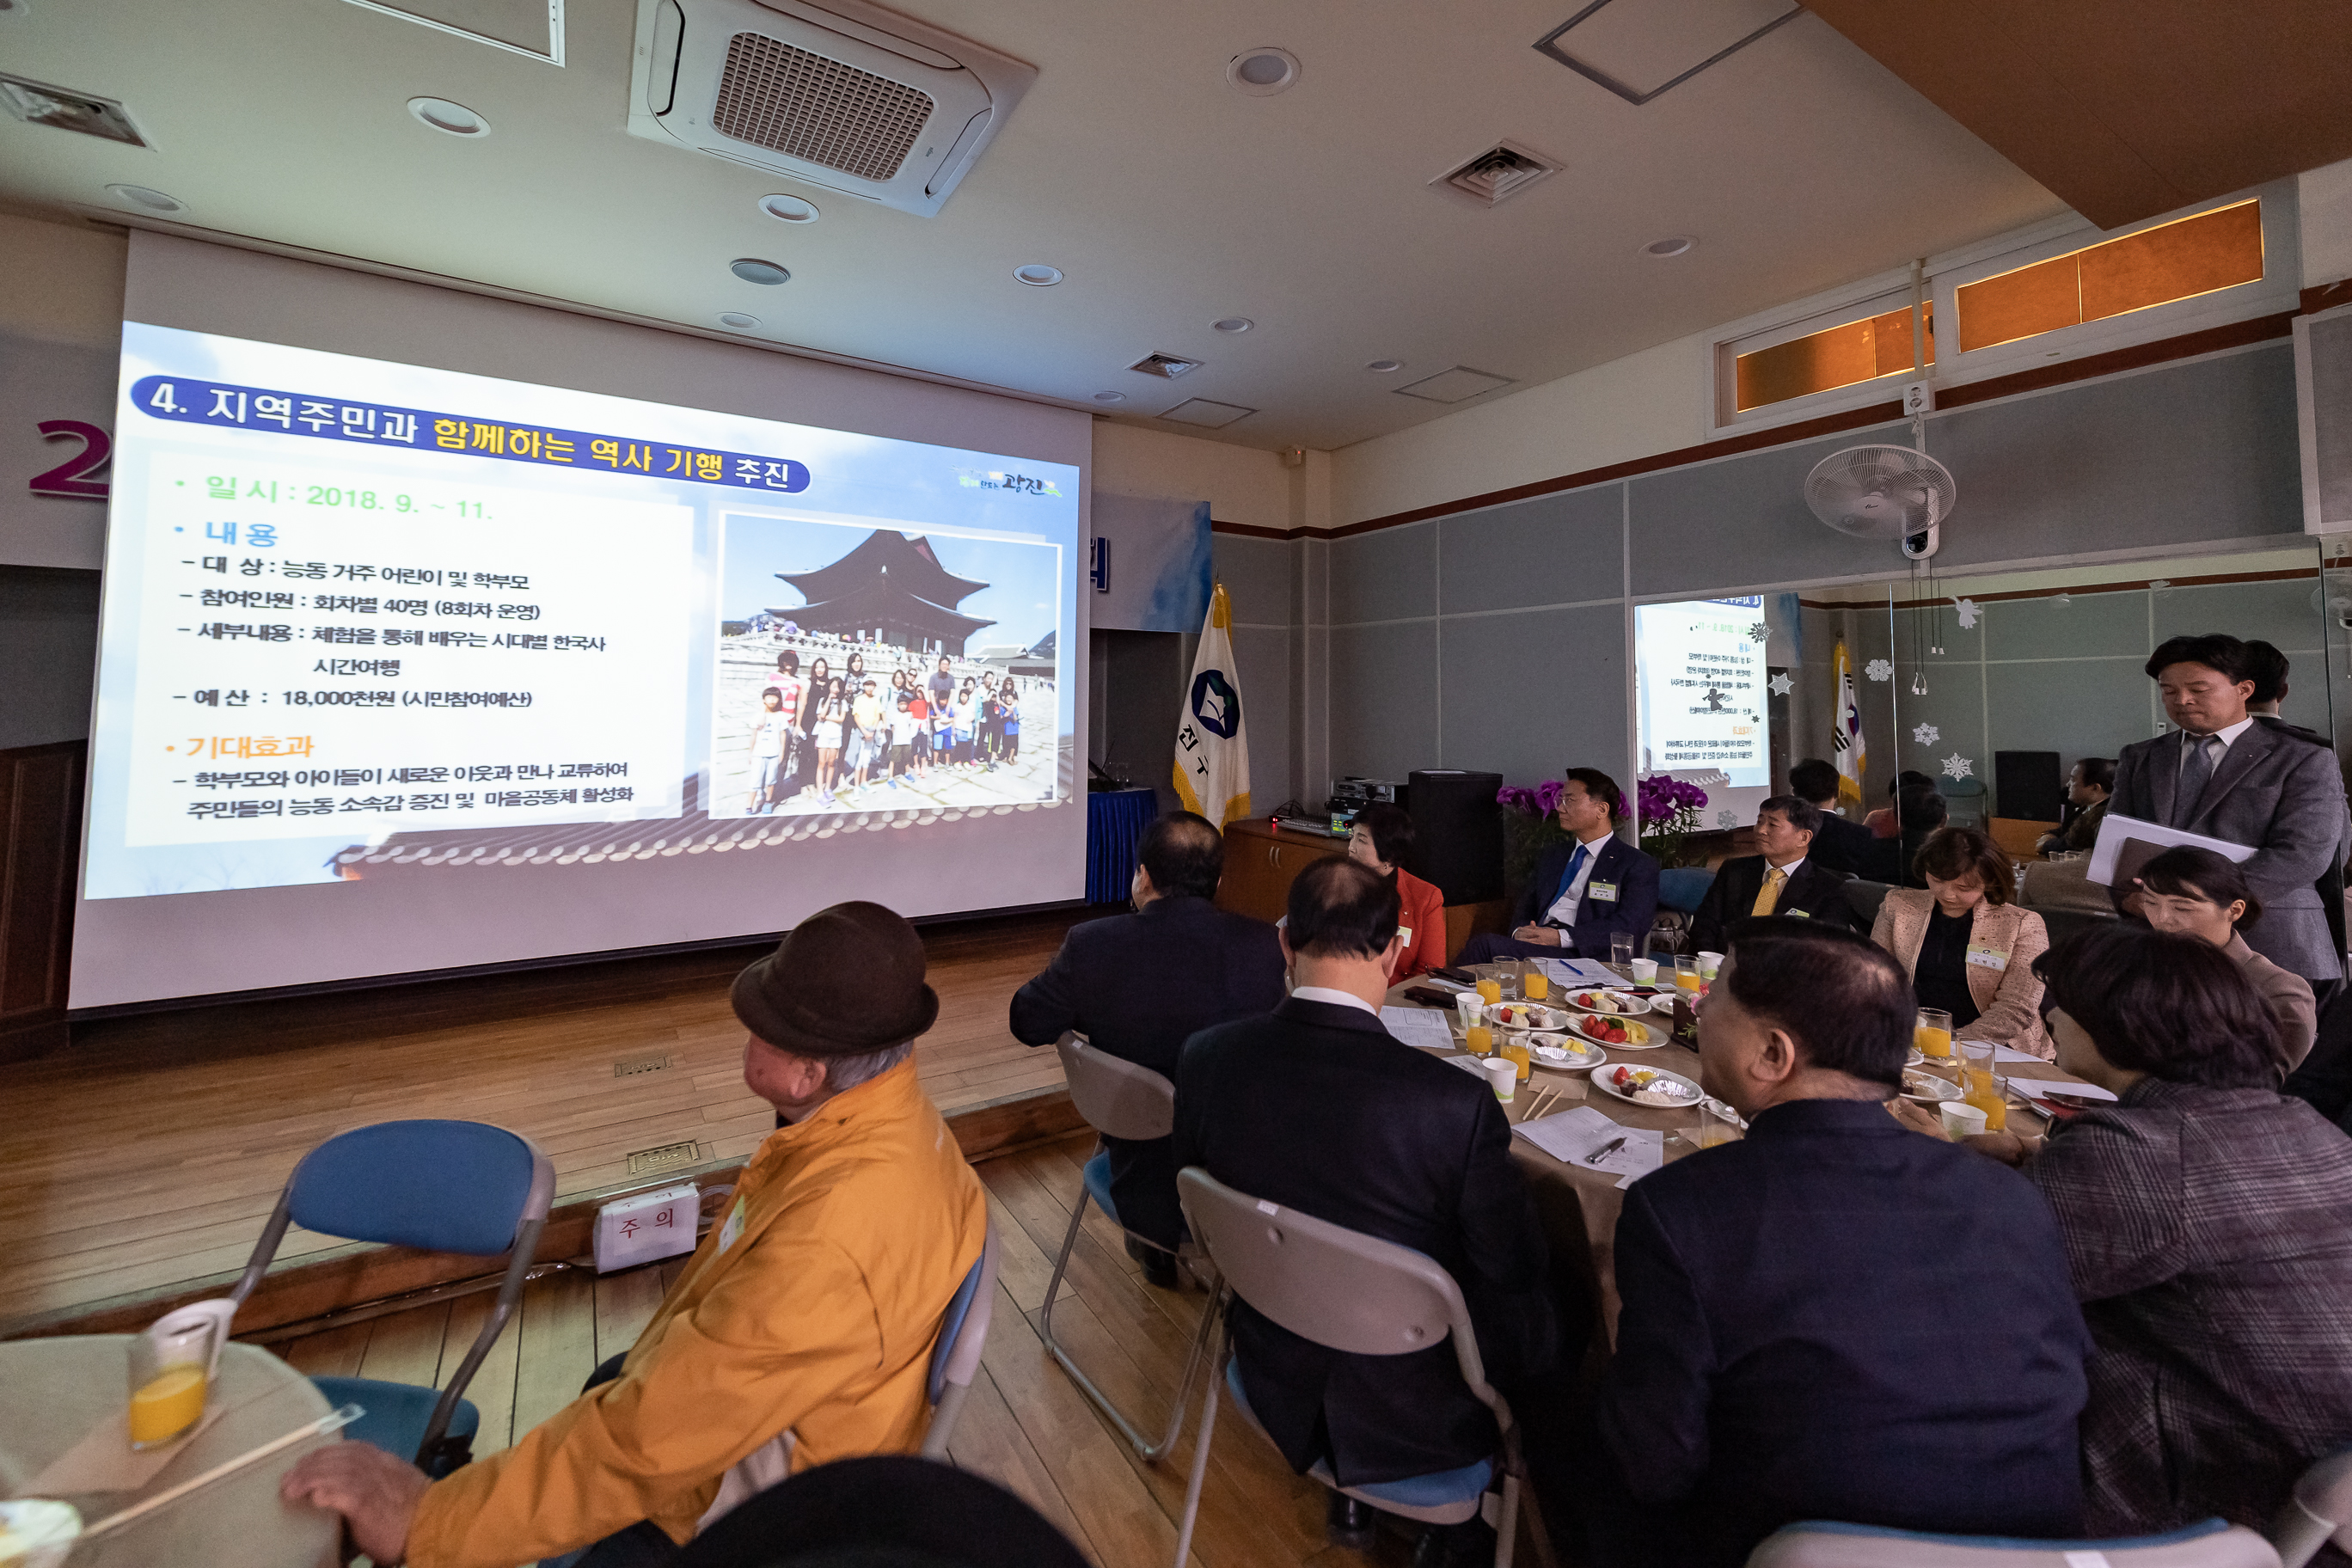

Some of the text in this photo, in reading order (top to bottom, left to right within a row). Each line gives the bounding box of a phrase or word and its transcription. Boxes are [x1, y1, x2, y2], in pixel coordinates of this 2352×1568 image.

[150, 383, 788, 489] 4. 지역주민과 함께하는 역사 기행 추진
[1002, 474, 1044, 495] 광진
[306, 486, 385, 510] 2018.
[395, 494, 420, 513] 9.
[456, 499, 493, 520] 11.
[281, 560, 328, 580] 능동
[333, 564, 377, 582] 거주
[382, 567, 443, 586] 어린이
[448, 571, 468, 588] 및
[473, 572, 530, 590] 학부모
[199, 588, 295, 609] 참여인원
[313, 594, 378, 614] 회차별
[383, 598, 428, 617] 40명
[435, 600, 493, 619] (8회차
[496, 603, 541, 622] 운영)
[198, 622, 294, 643] 세부내용
[312, 626, 377, 645] 체험을
[382, 628, 424, 646] 통해
[429, 631, 488, 648] 배우는
[492, 634, 548, 651] 시대별
[554, 635, 607, 652] 한국사
[313, 658, 401, 677] 시간여행
[282, 690, 395, 707] 18,000천원
[401, 690, 533, 708] (시민참여예산)
[186, 735, 315, 760] 기대효과
[194, 762, 628, 790] 학부모와 아이들이 새로운 이웃과 만나 교류하여
[187, 787, 634, 820] 주민들의 능동 소속감 증진 및 마을공동체 활성화
